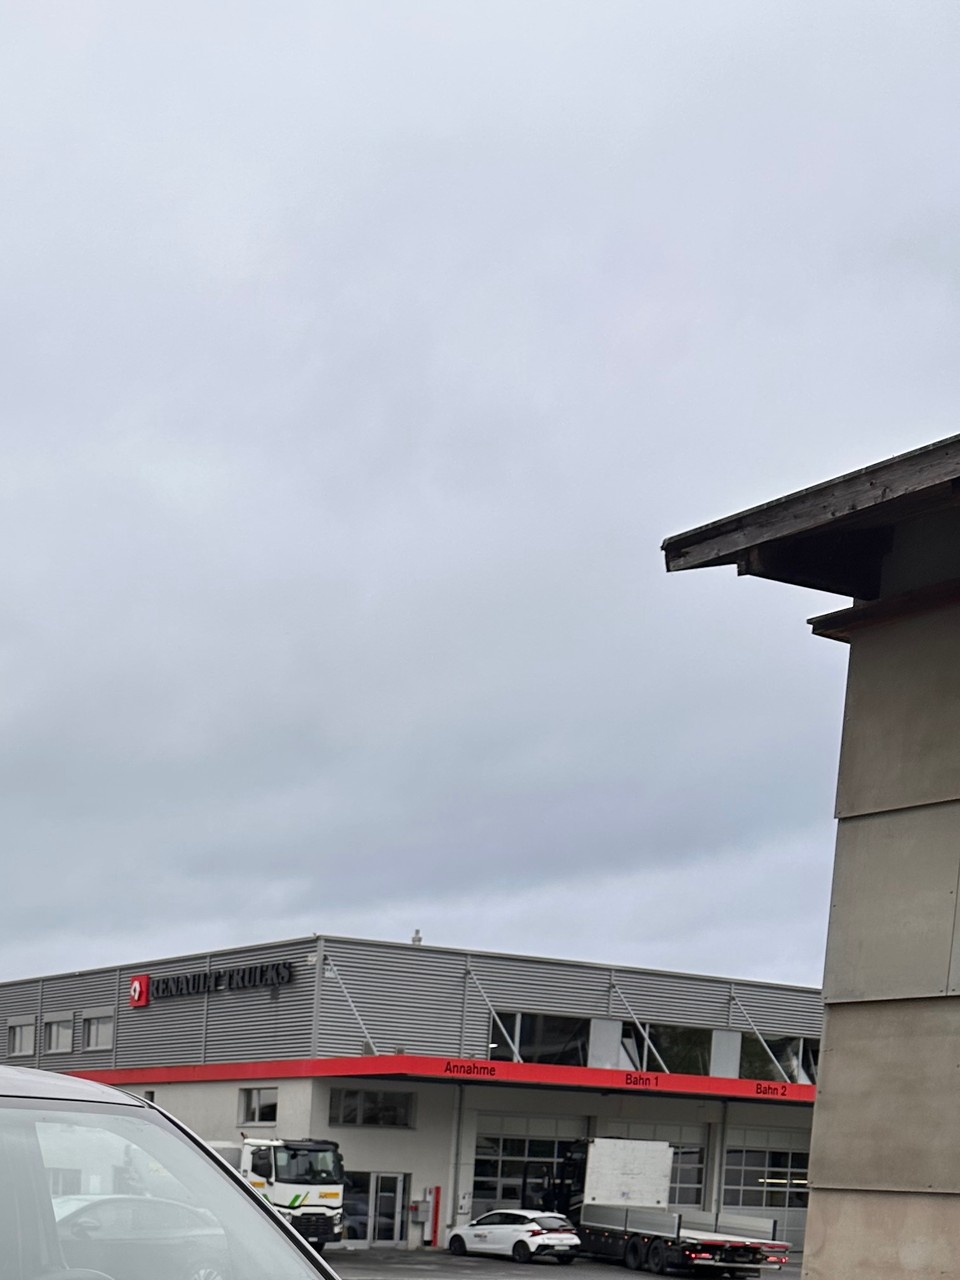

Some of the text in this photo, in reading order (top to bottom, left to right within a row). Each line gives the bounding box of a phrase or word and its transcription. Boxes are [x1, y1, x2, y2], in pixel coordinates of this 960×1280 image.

[149, 962, 292, 998] RENAULT TRUCKS
[444, 1061, 496, 1076] Annahme
[625, 1073, 659, 1086] Bahn 1
[756, 1083, 787, 1096] Bahn 2
